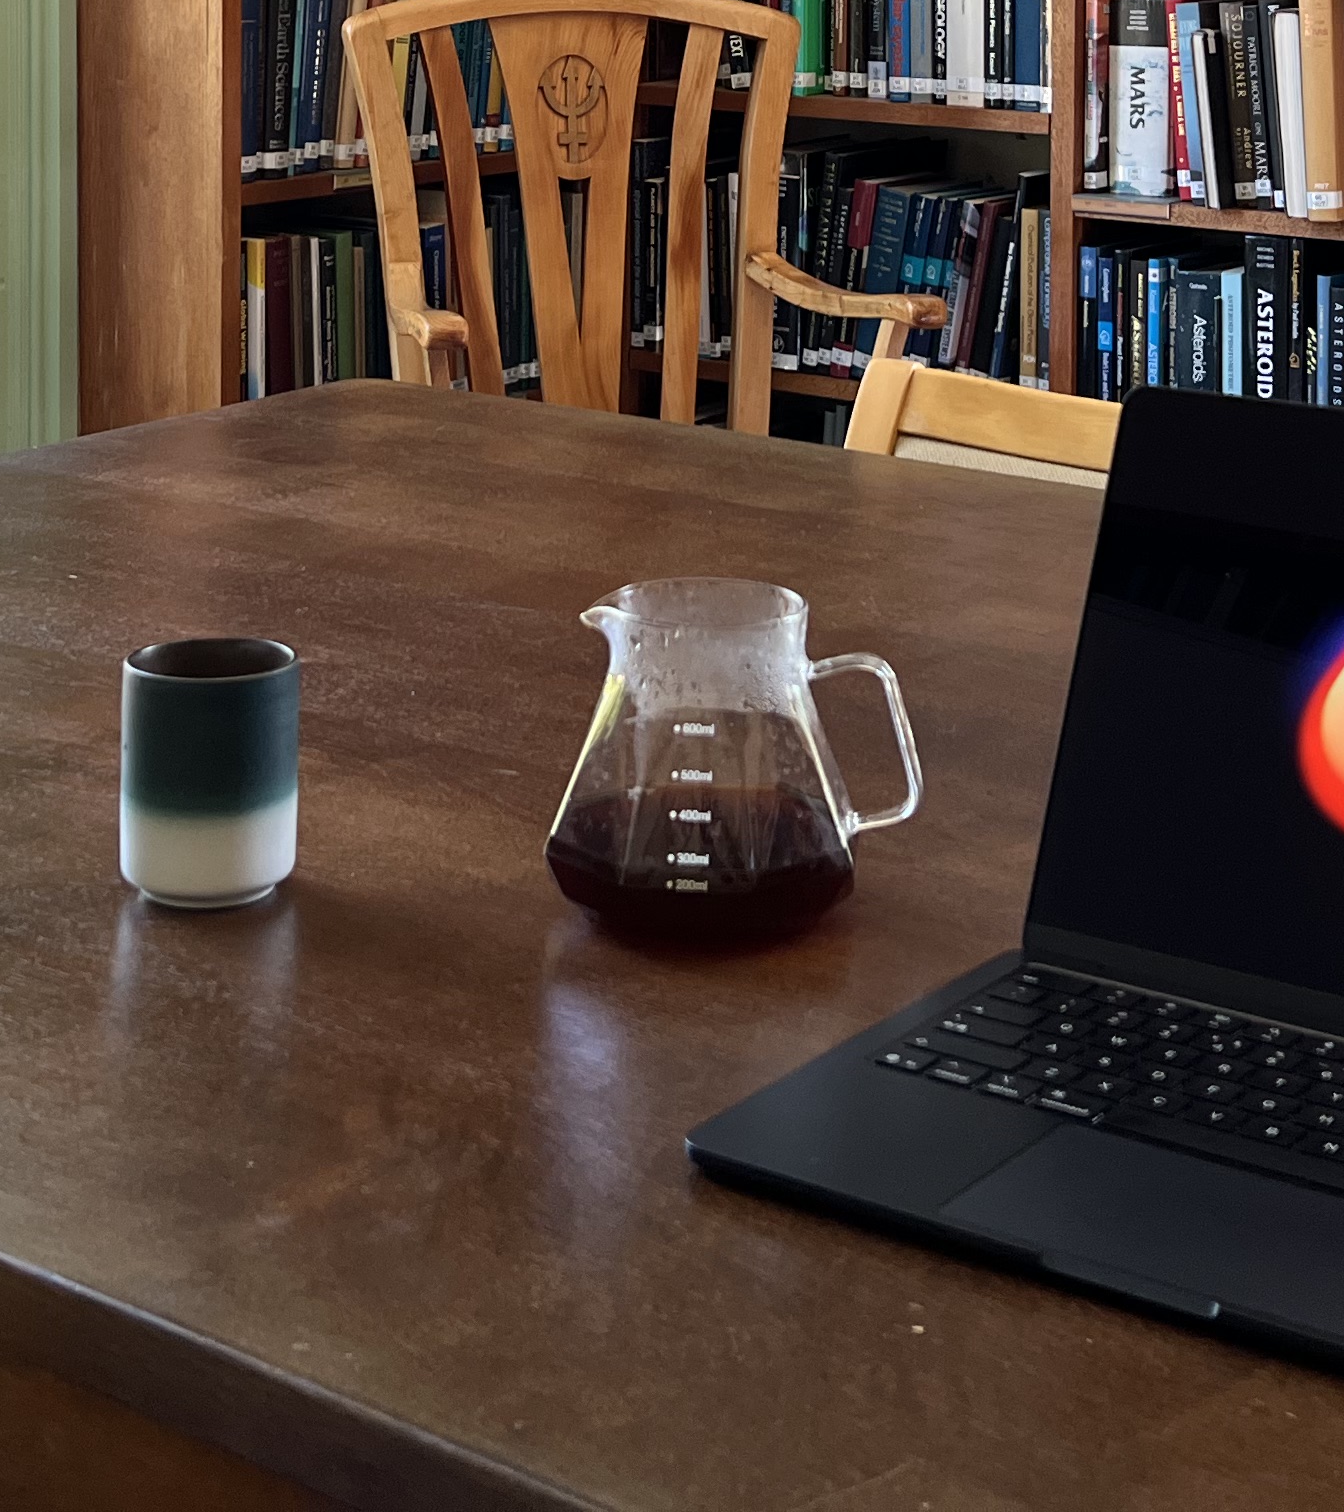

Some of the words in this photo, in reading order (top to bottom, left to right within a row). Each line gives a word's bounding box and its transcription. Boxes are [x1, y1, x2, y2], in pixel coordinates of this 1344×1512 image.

[1231, 14, 1246, 98] SOJOURNER
[1247, 36, 1258, 77] PATRICK
[1129, 65, 1146, 129] MARS
[1251, 79, 1261, 116] MOORE
[1255, 122, 1262, 135] ON
[1255, 141, 1269, 181] MARS
[1256, 288, 1274, 399] ASTEROID
[1333, 302, 1343, 406] ASTEROIDS
[682, 722, 715, 735] 600ml
[681, 769, 713, 782] 500ml
[678, 809, 712, 822] 400ml
[676, 852, 710, 865] 300ml
[675, 879, 708, 893] 200ml
